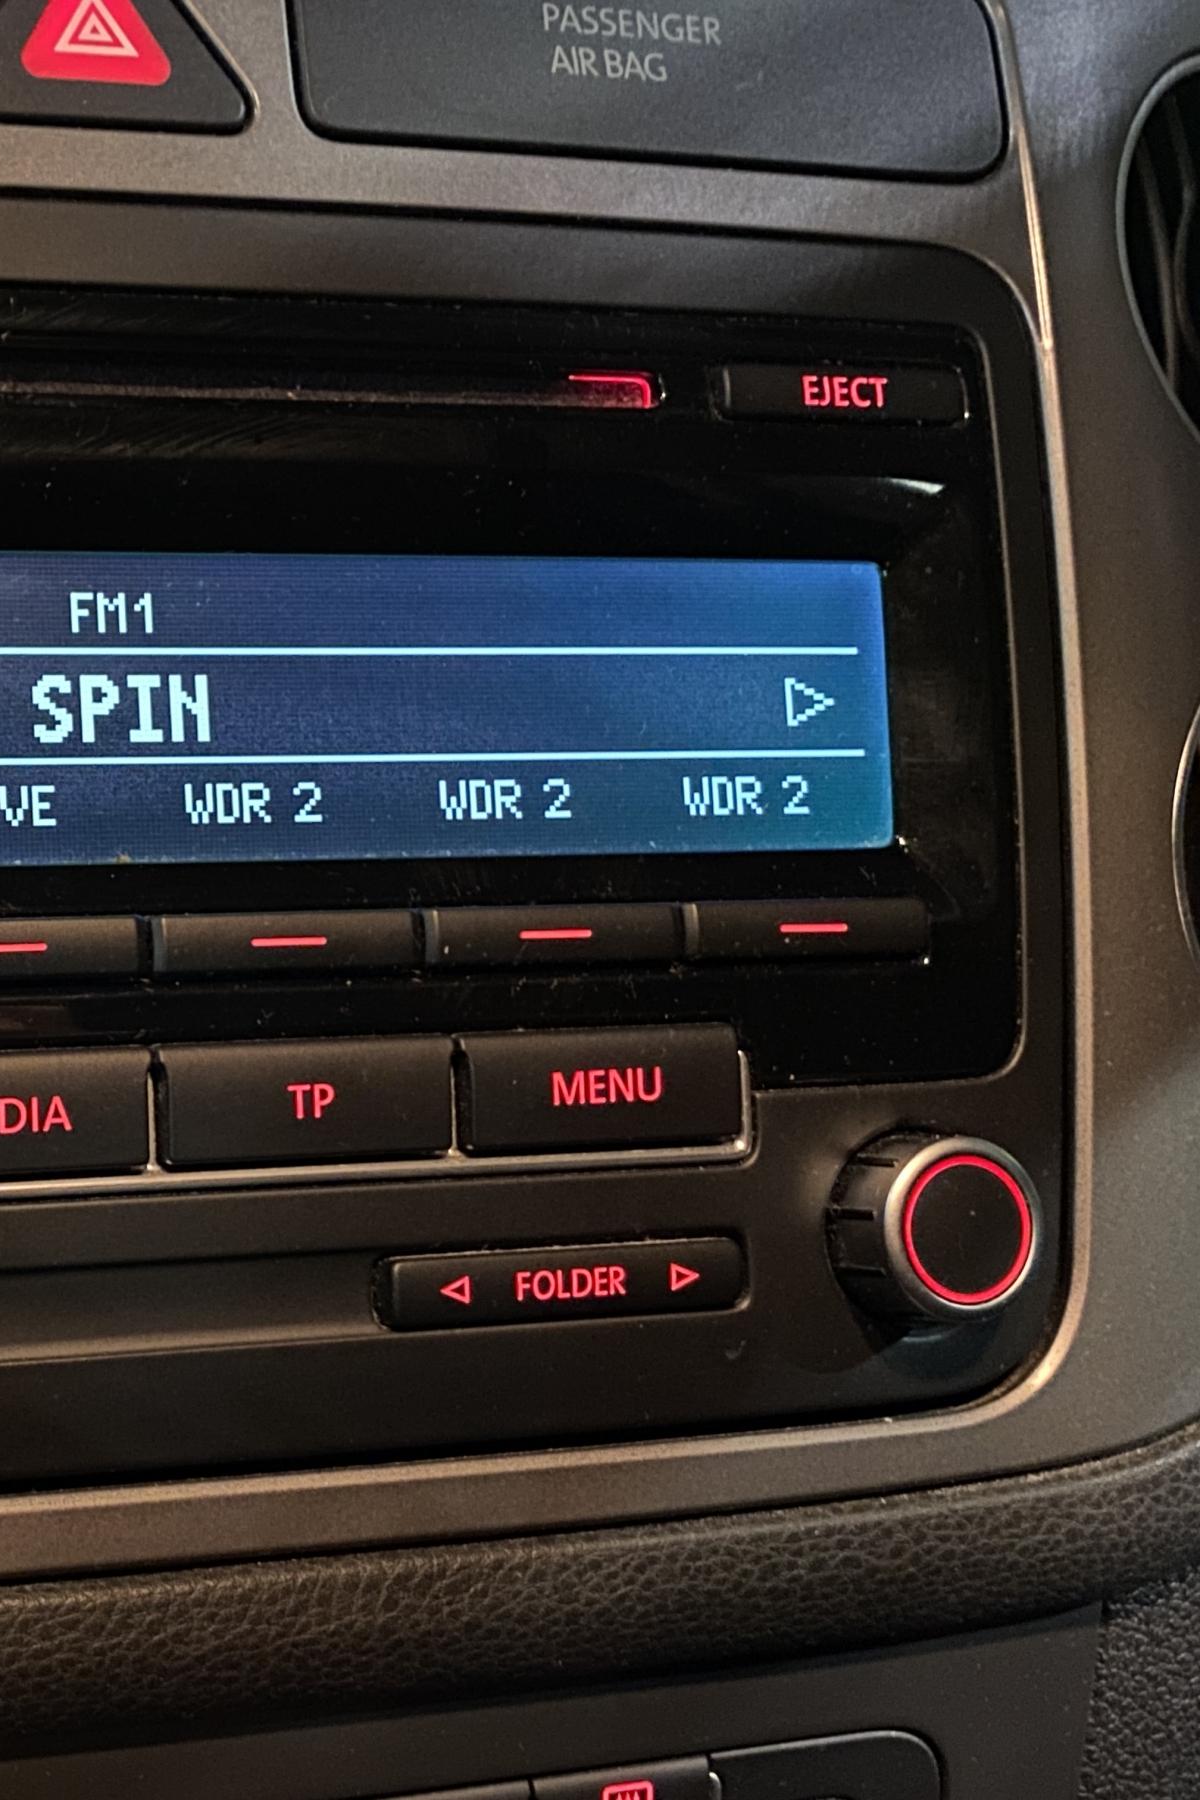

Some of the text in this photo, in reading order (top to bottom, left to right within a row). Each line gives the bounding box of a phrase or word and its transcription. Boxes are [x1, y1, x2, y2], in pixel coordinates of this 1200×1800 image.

[542, 2, 722, 47] PASSENGER
[550, 43, 668, 84] AIR BAG
[800, 374, 888, 409] EJECT
[68, 591, 155, 635] FM1
[31, 673, 212, 744] SPIN
[183, 781, 323, 825] WDR 2
[438, 777, 573, 821] WDR 2
[682, 774, 812, 817] WDR 2
[286, 1082, 336, 1120] TP
[550, 1065, 664, 1108] MENU
[514, 1265, 627, 1303] FOLDER
